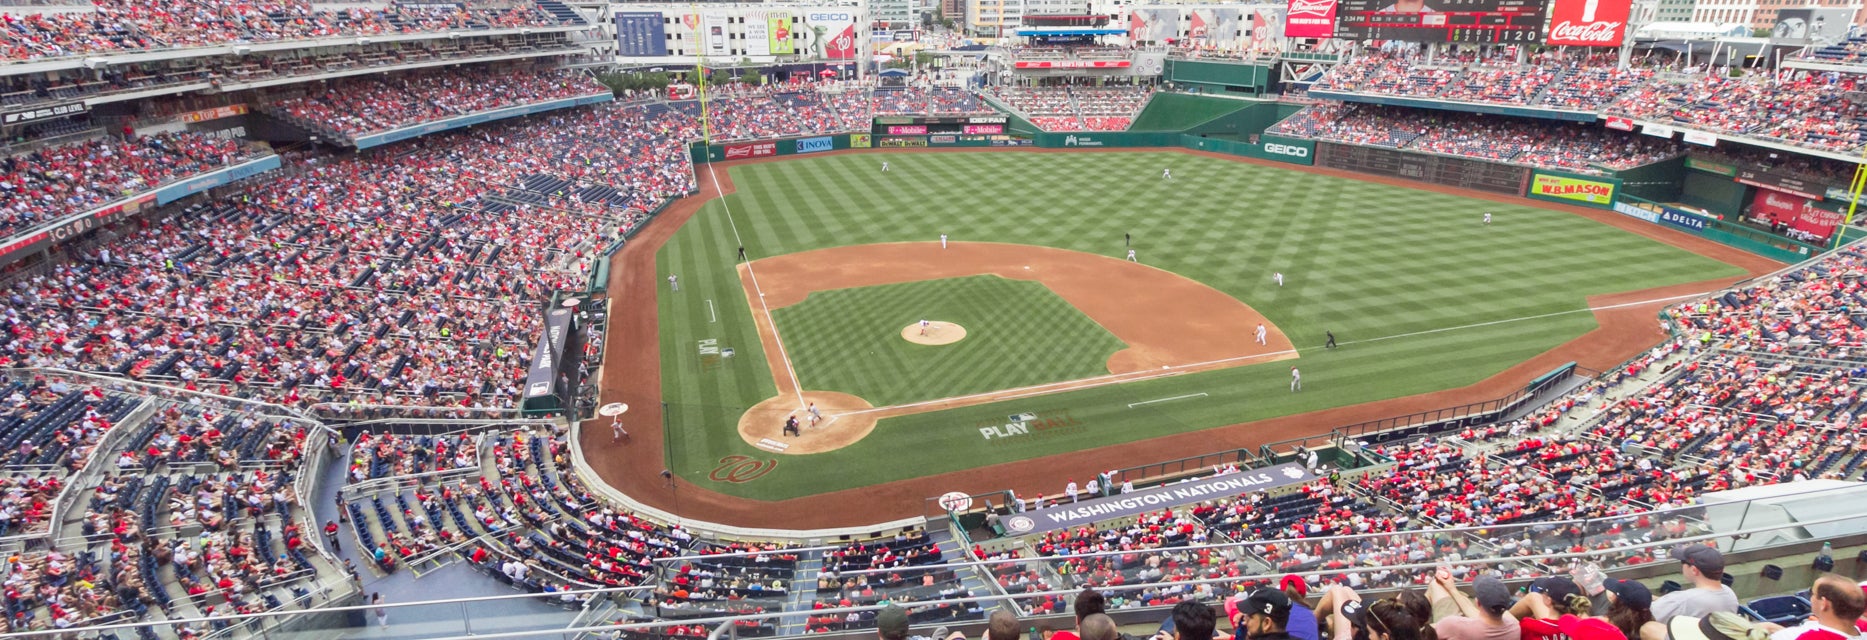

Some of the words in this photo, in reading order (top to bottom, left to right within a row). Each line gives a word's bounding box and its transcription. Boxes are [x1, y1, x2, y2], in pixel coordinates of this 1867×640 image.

[1515, 31, 1523, 40] 2
[1527, 31, 1535, 40] 0
[1551, 21, 1622, 42] Coca-Cola
[54, 105, 68, 115] CLUB
[68, 104, 83, 113] LEVEL
[806, 140, 832, 149] INOVA
[1264, 143, 1308, 157] GEICO
[1672, 214, 1702, 228] DELTA
[979, 421, 1029, 440] PLAY
[1047, 488, 1174, 524] WASHINGTON
[1172, 472, 1274, 501] NATIONALS
[1263, 602, 1274, 615] 3
